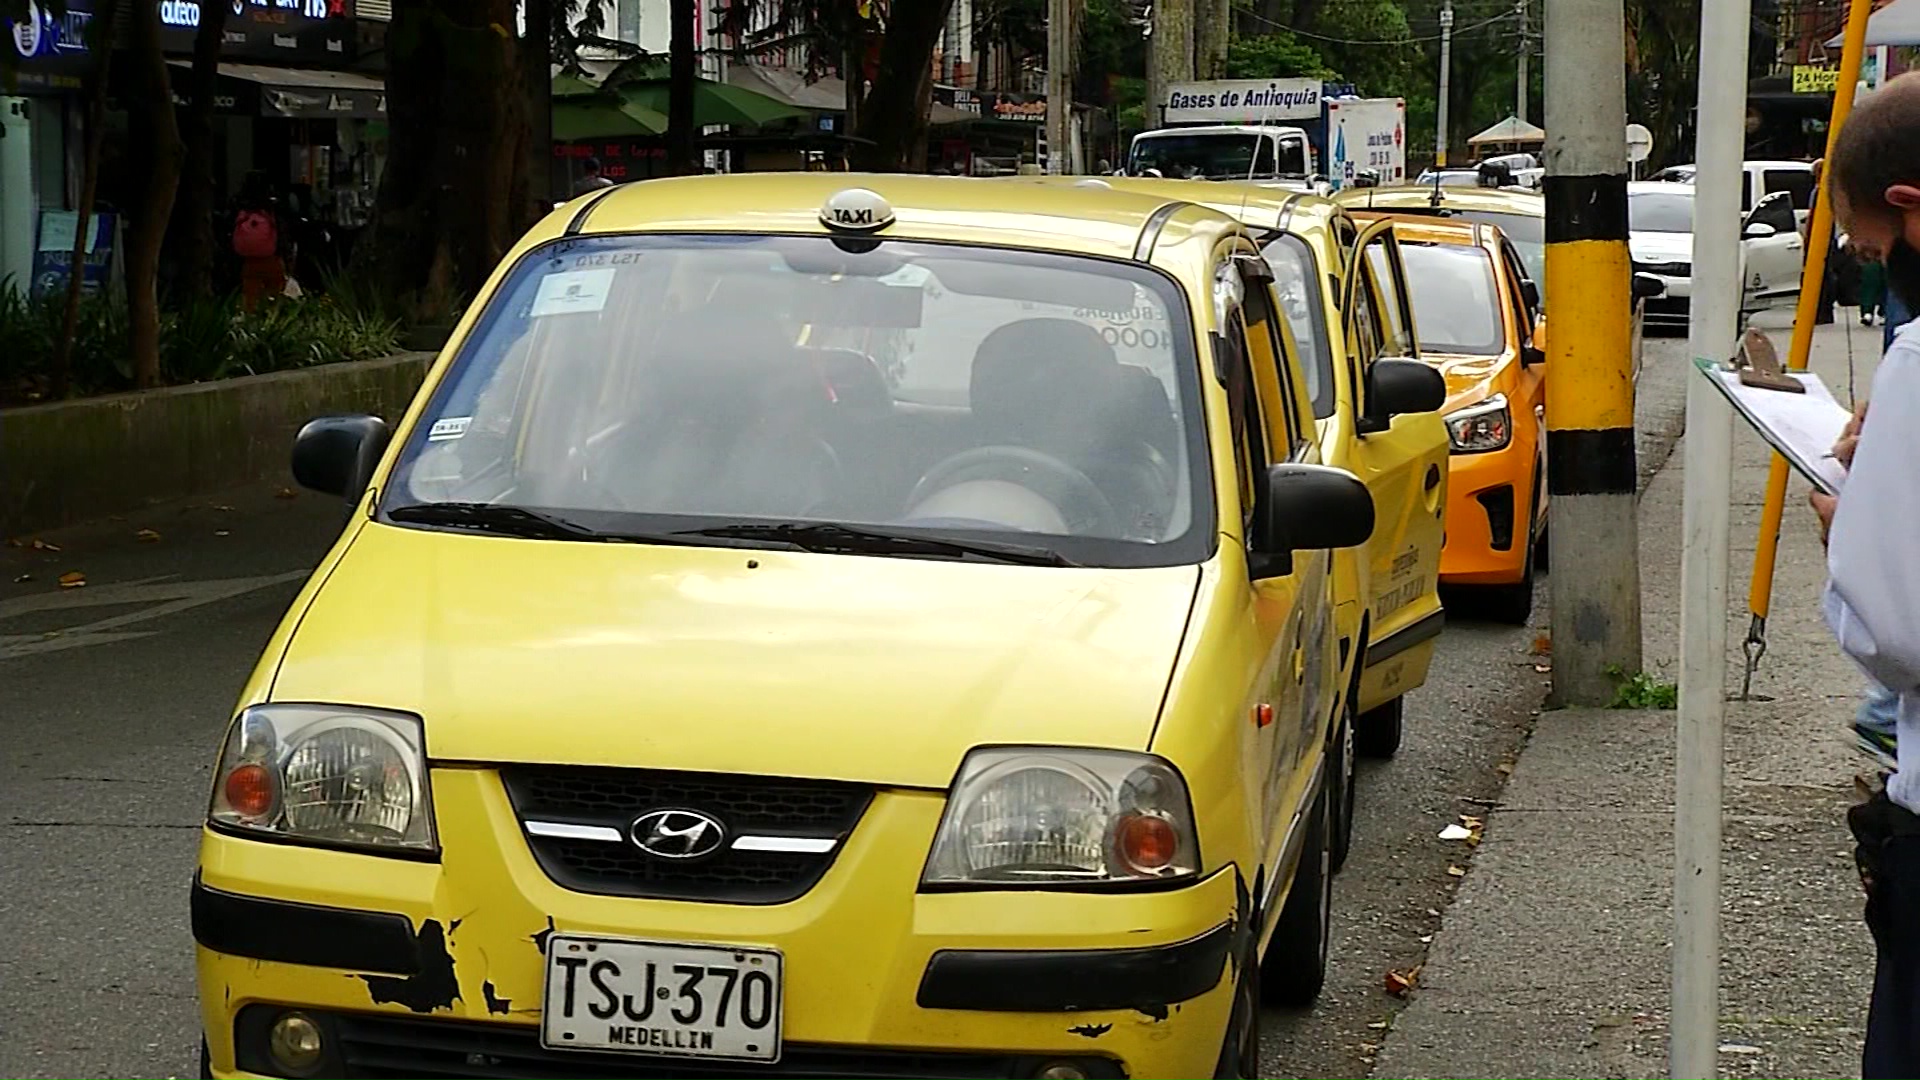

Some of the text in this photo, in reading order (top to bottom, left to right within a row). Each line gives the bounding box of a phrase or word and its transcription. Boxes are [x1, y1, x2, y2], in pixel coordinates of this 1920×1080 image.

[161, 0, 200, 26] auteco
[1796, 73, 1810, 83] 24
[1170, 88, 1318, 109] Gases de Antioquia
[833, 208, 872, 223] TAXI
[608, 1024, 713, 1050] MEDELLIN
